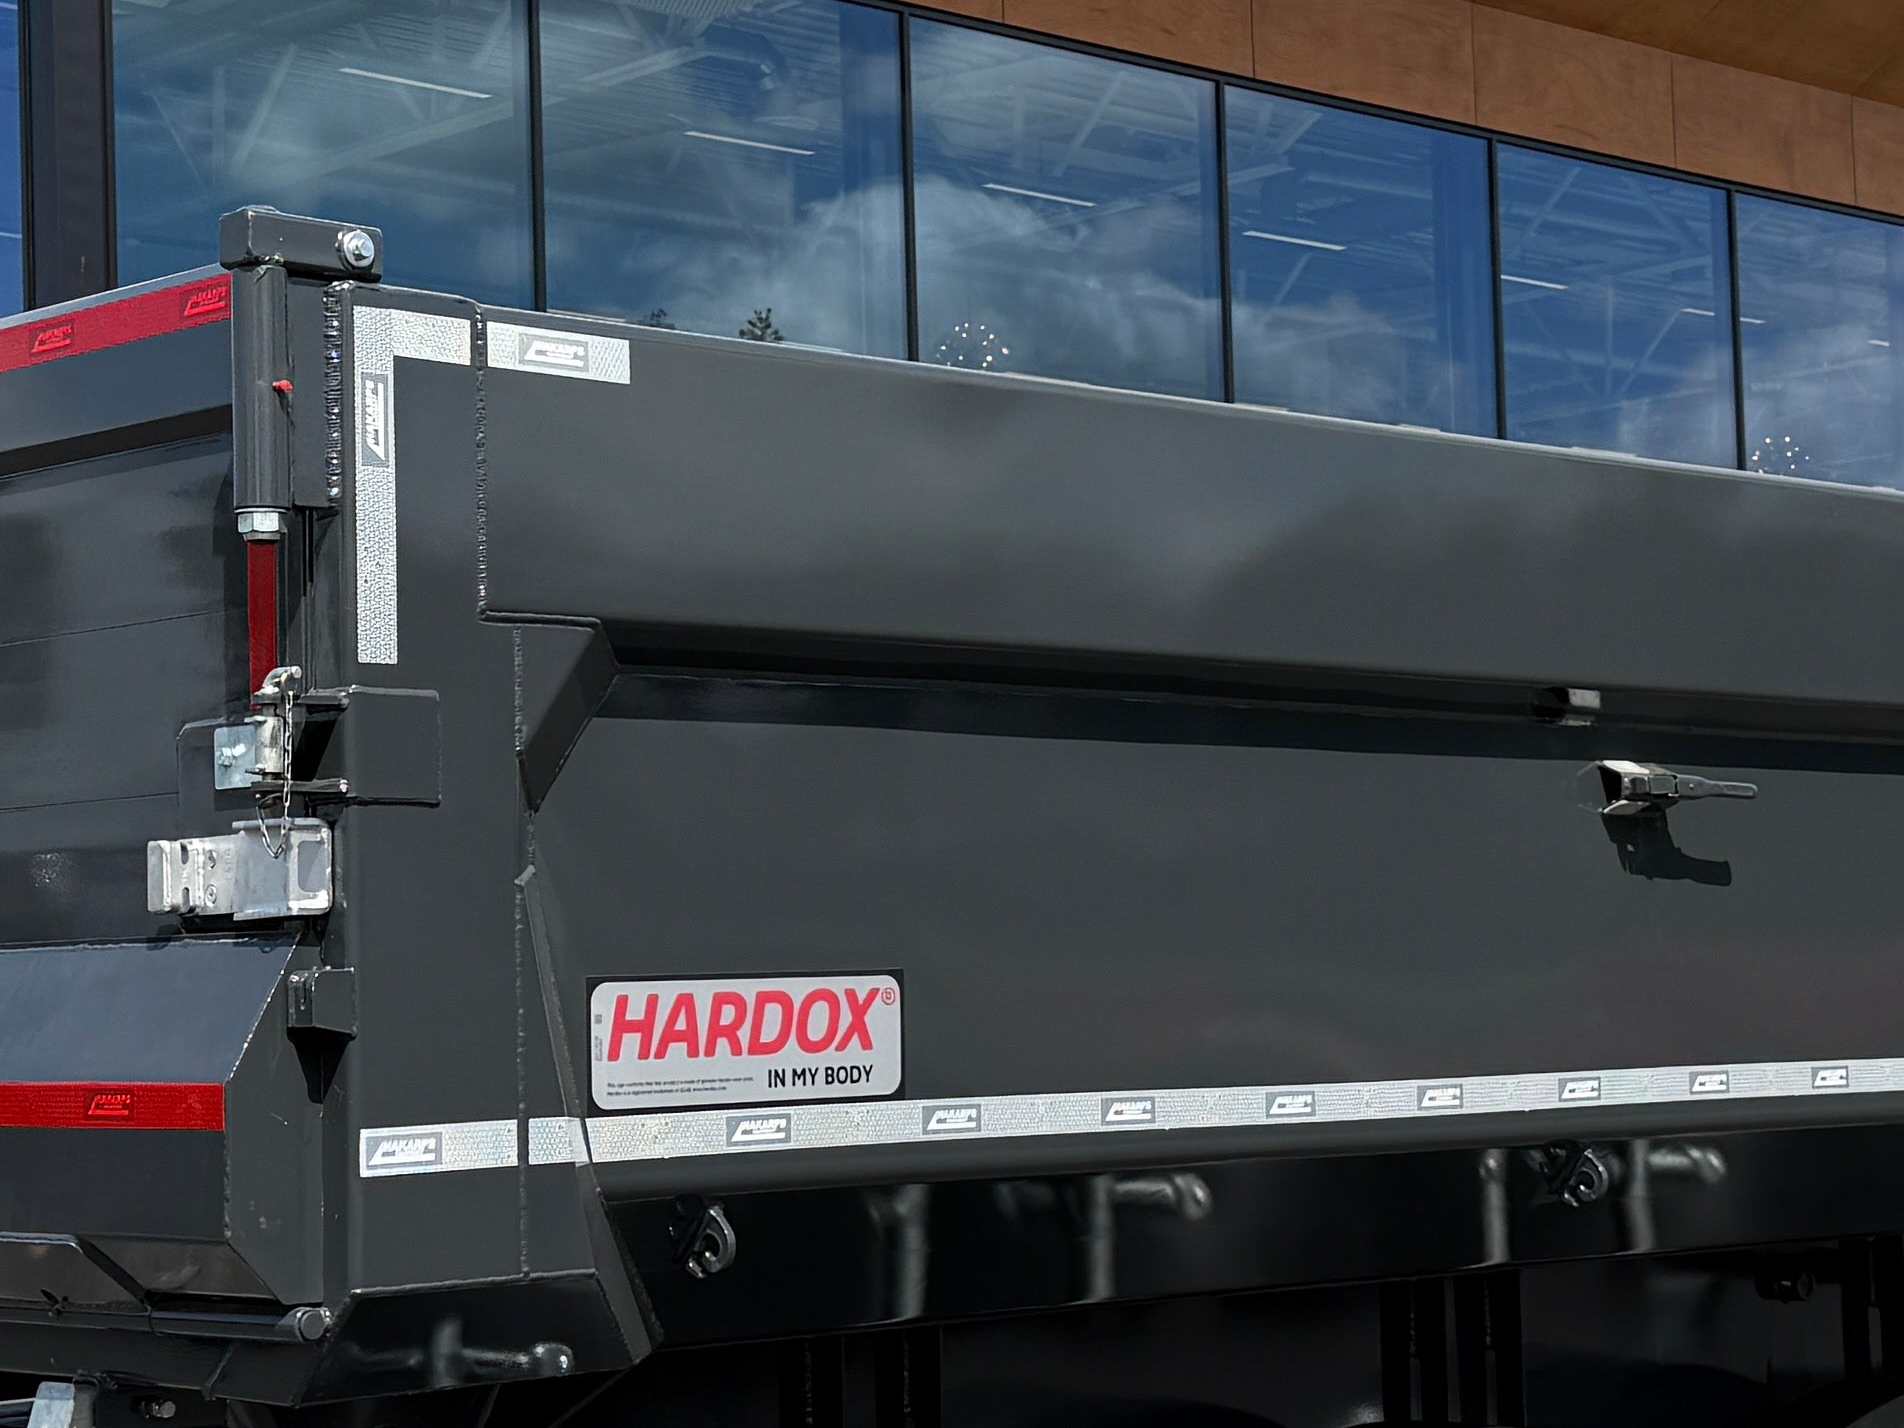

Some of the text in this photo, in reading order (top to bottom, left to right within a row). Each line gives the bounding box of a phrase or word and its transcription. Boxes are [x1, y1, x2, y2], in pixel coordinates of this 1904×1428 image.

[607, 988, 880, 1062] HARDOX
[767, 1068, 787, 1089] IN
[791, 1067, 819, 1087] MY
[824, 1064, 874, 1086] BODY
